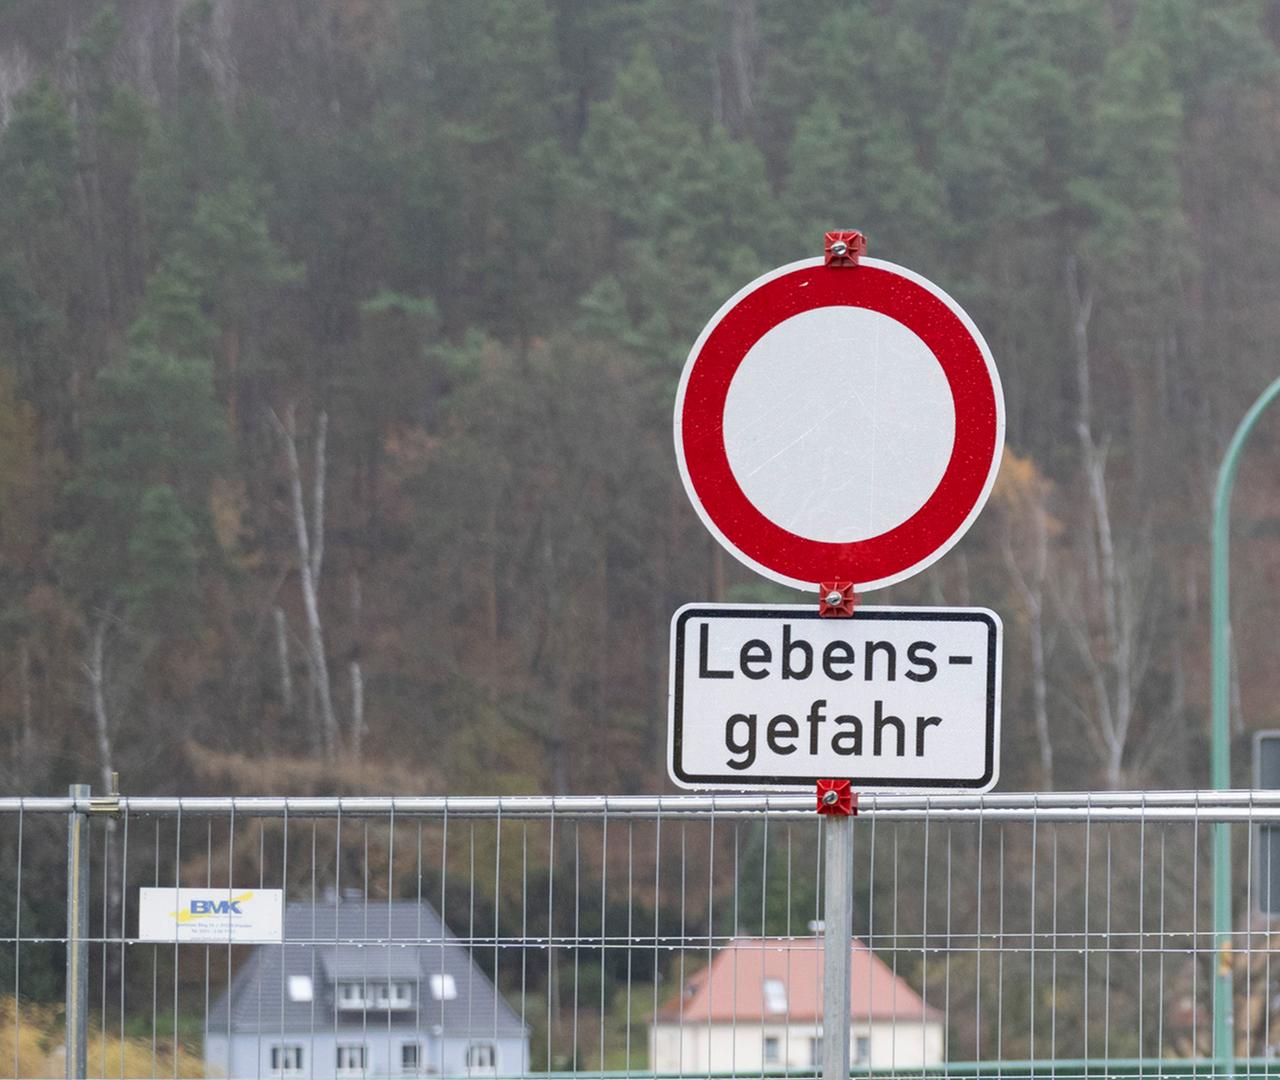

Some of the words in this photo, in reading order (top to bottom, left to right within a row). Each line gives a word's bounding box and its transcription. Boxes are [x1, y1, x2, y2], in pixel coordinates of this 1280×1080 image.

[698, 622, 973, 683] Lebens-
[725, 698, 943, 771] gefahr
[190, 901, 242, 914] BMK
